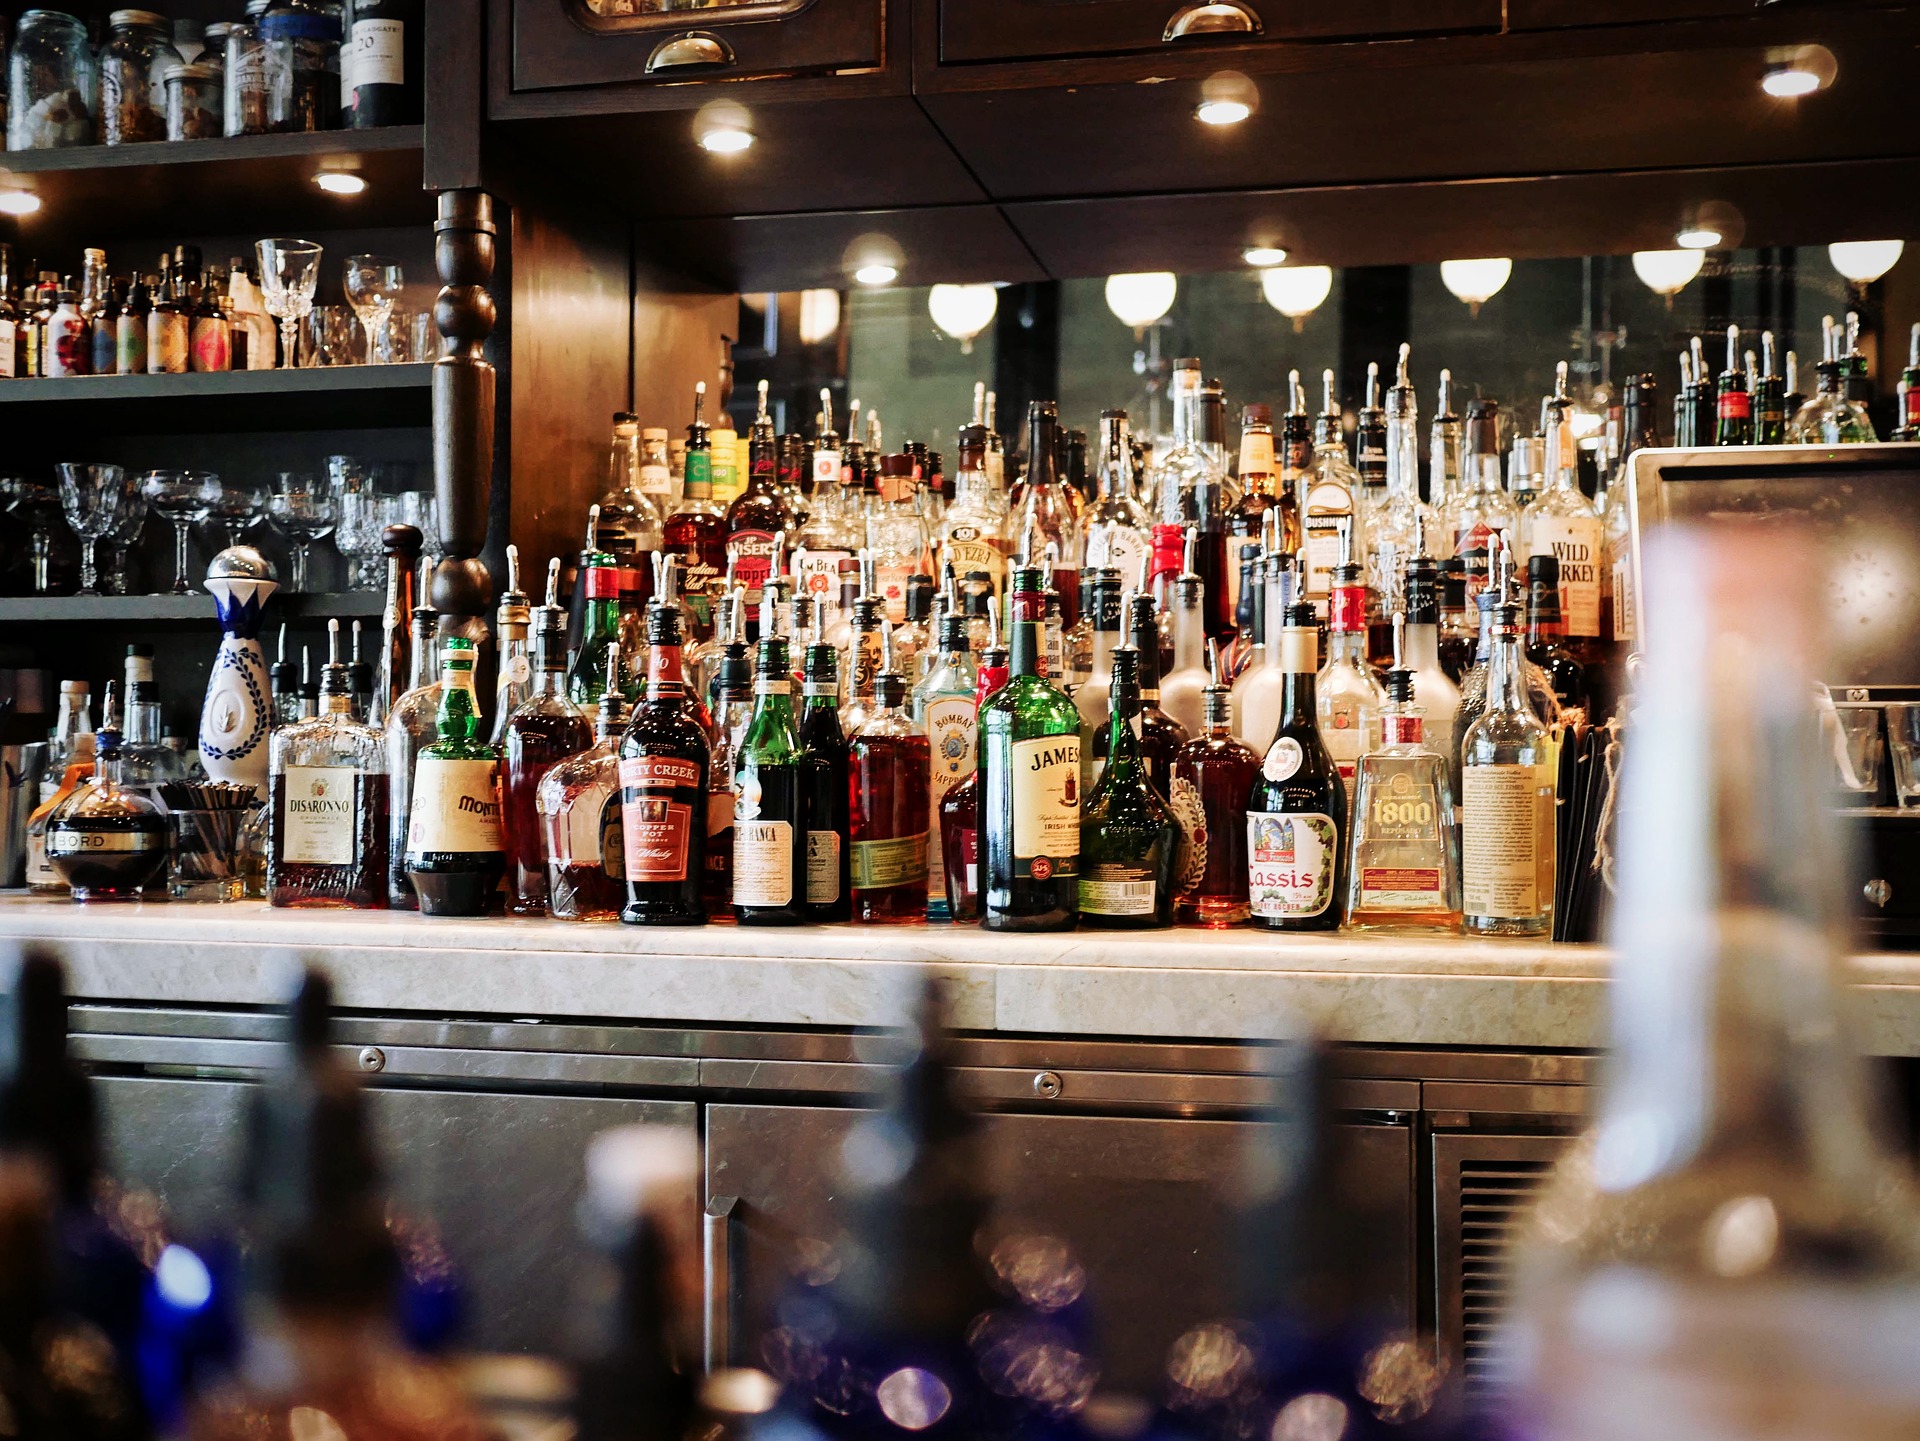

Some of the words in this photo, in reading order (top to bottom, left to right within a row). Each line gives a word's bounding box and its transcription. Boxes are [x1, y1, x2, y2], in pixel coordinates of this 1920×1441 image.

[358, 36, 374, 52] 20
[956, 528, 977, 539] 101
[1552, 541, 1589, 562] WILD
[1561, 563, 1596, 583] RKEY
[934, 713, 975, 731] BOMBAY
[1031, 746, 1080, 772] JAMES
[653, 764, 695, 780] CREEK
[290, 800, 350, 814] DISARONNO
[1372, 801, 1431, 826] 1800
[633, 824, 675, 832] COPPER
[636, 848, 673, 862] Whisky
